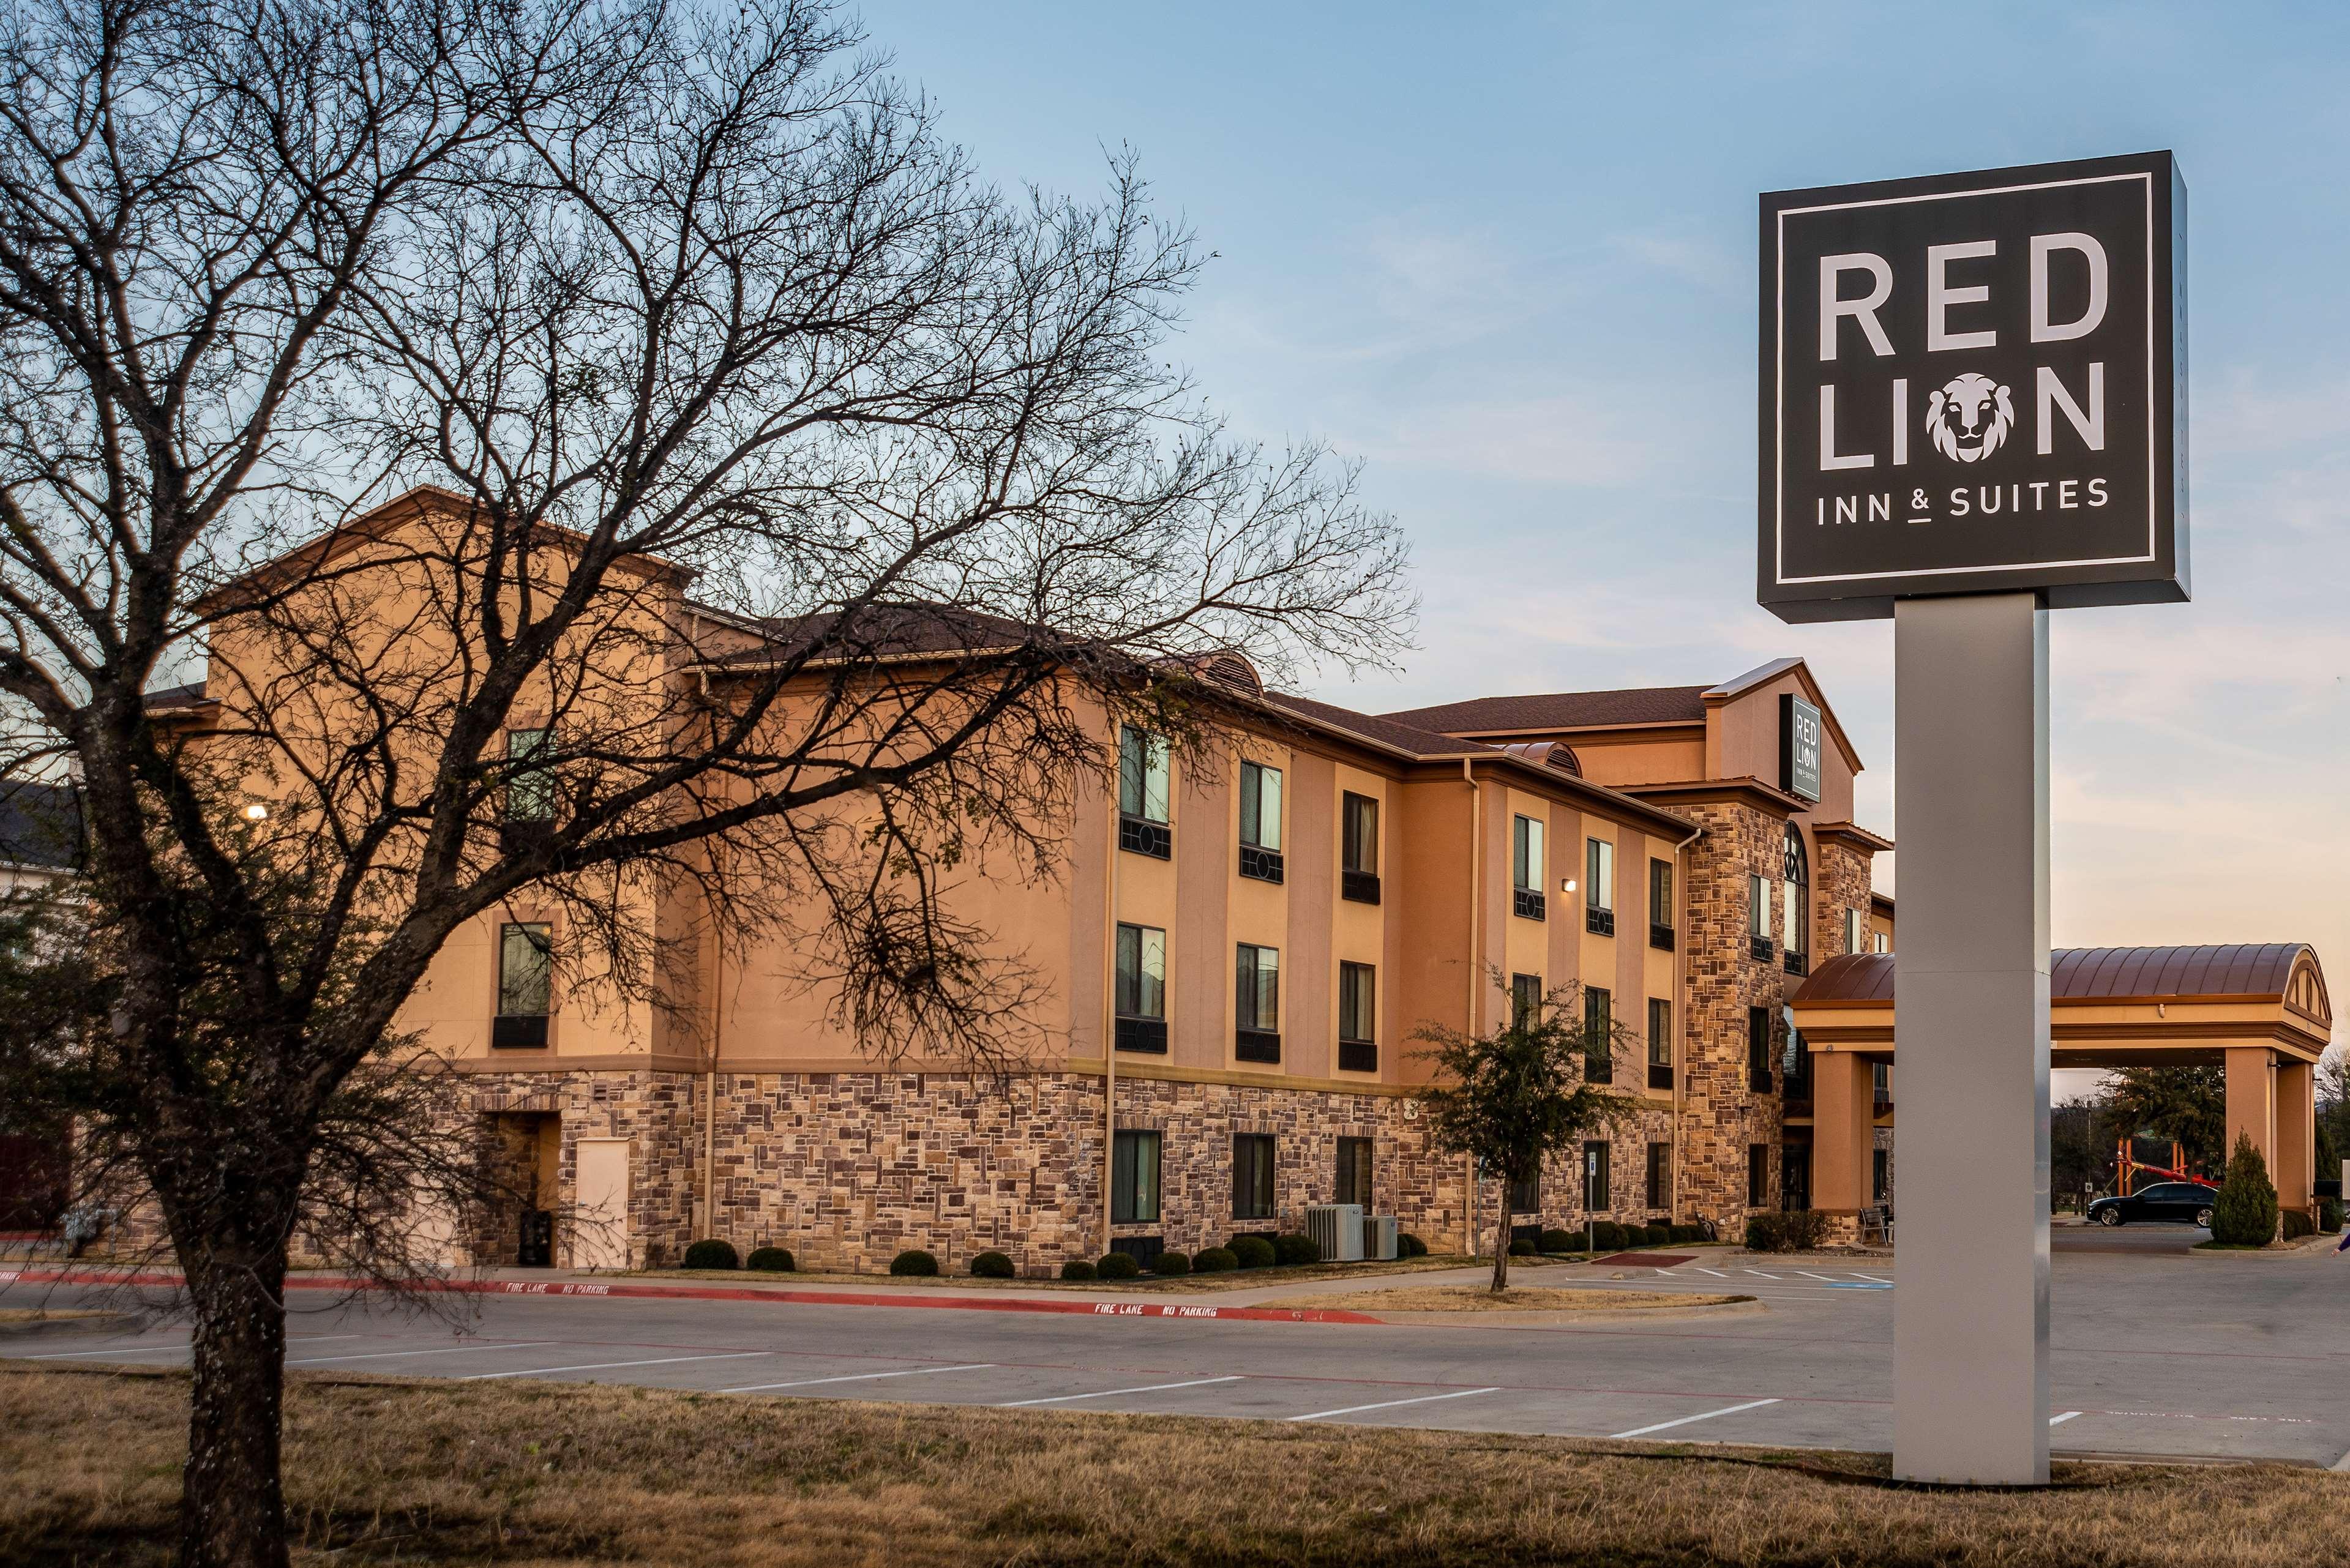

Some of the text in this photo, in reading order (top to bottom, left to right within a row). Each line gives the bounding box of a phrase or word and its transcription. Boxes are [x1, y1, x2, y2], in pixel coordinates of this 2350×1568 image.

[1820, 232, 2108, 362] RED
[1818, 478, 2108, 525] INN & SUITES
[1797, 714, 1817, 746] RED
[506, 1283, 609, 1295] FIRE LANE NO PARKING
[1095, 1303, 1218, 1317] FIRE LANE NO PARKING
